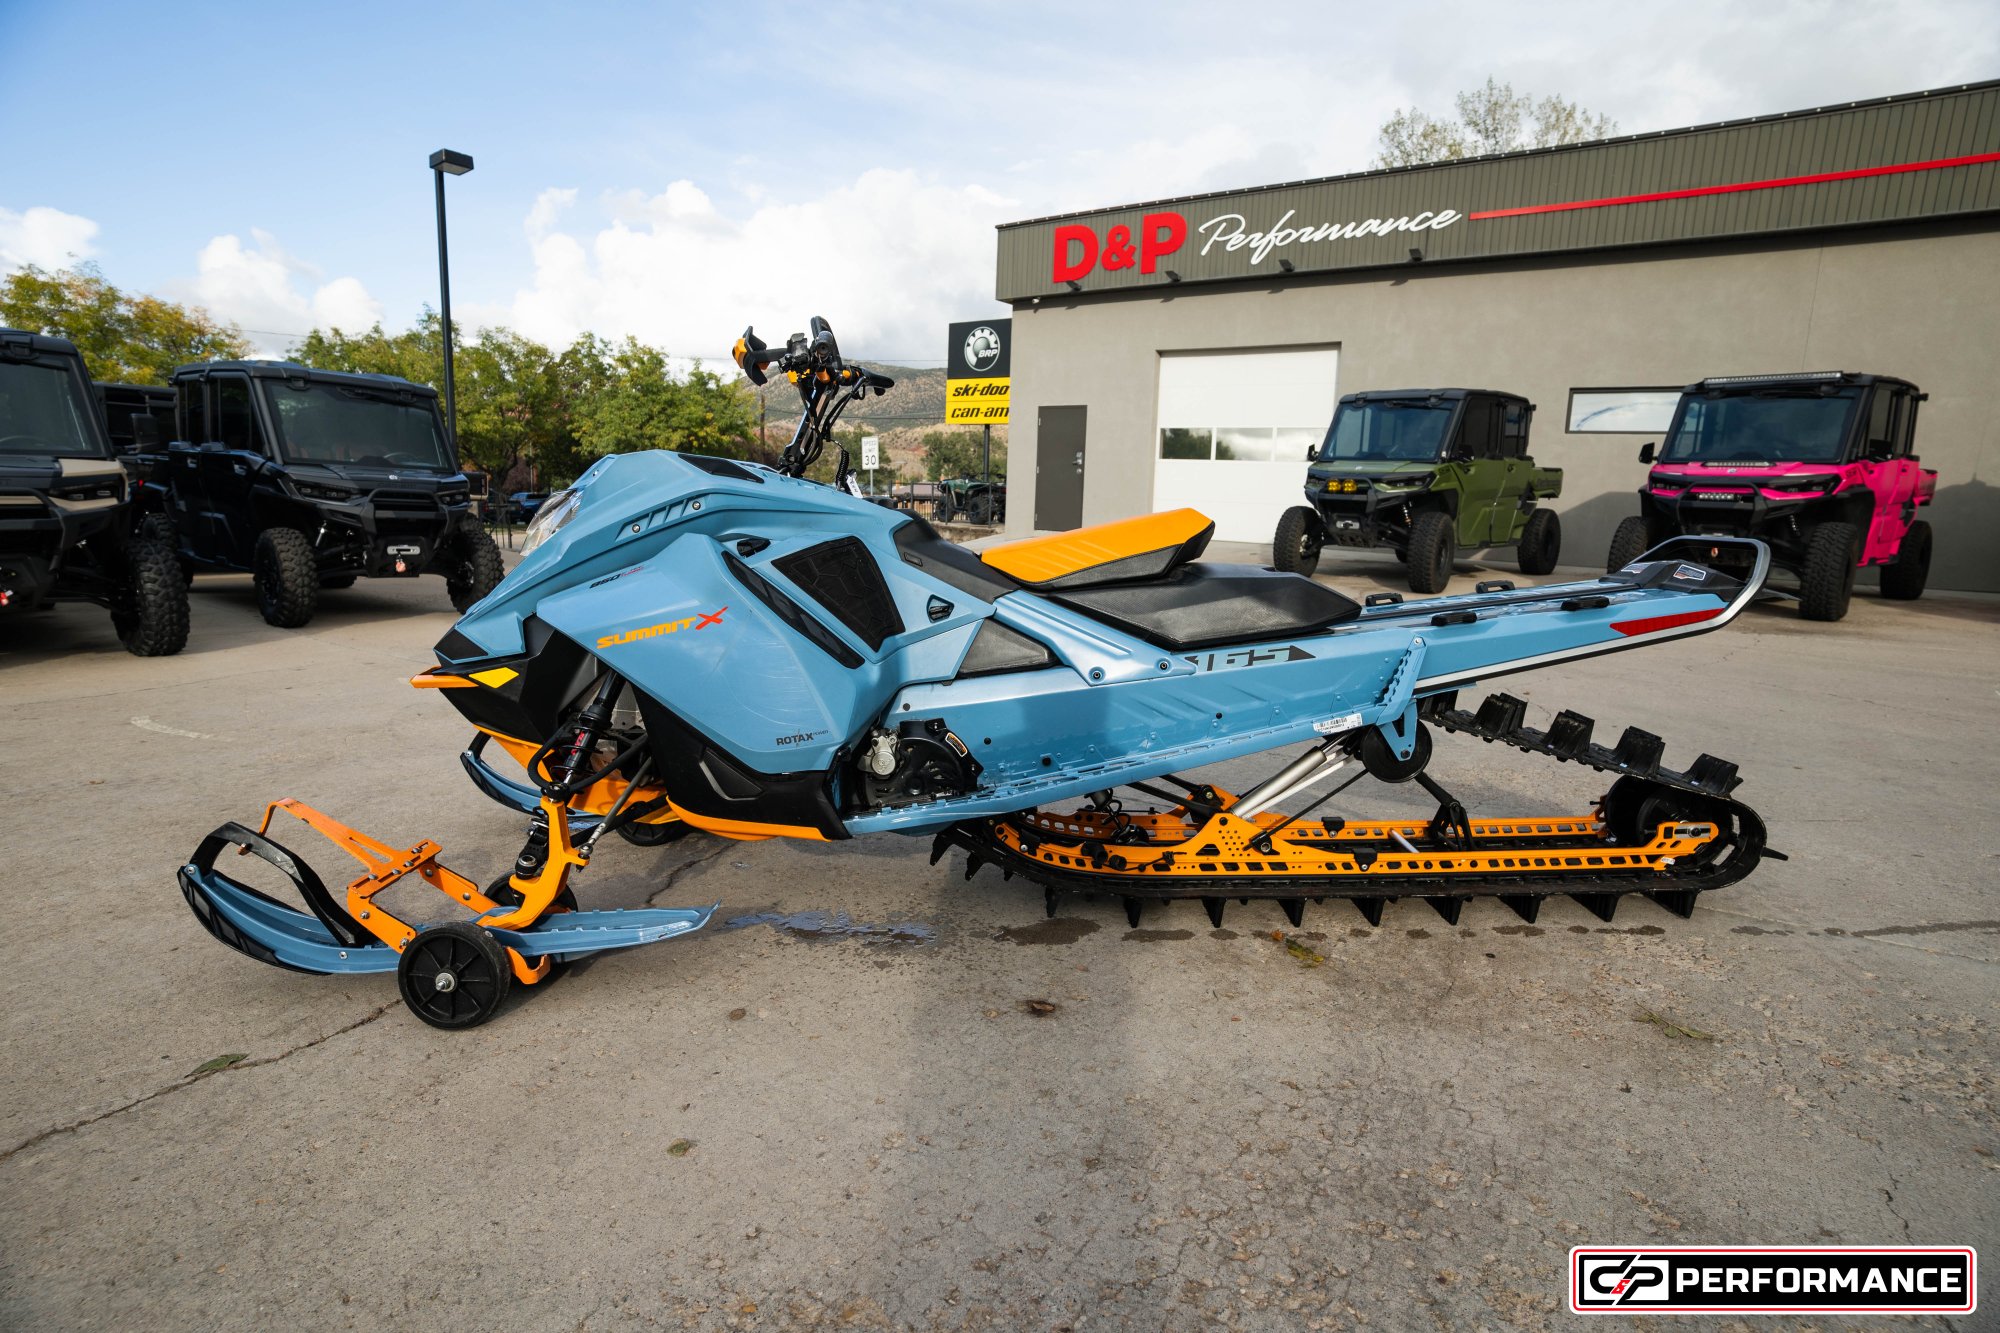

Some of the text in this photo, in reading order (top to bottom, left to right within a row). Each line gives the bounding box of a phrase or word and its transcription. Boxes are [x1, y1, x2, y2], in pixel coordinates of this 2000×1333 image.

[1053, 208, 1463, 283] D&P Performance
[978, 348, 998, 359] BRP
[952, 383, 1009, 397] ski-doo
[951, 406, 1009, 419] can-am
[864, 454, 877, 466] 30
[596, 605, 729, 650] SUMMIT X
[1190, 646, 1291, 673] 165
[775, 731, 814, 746] ROTAX
